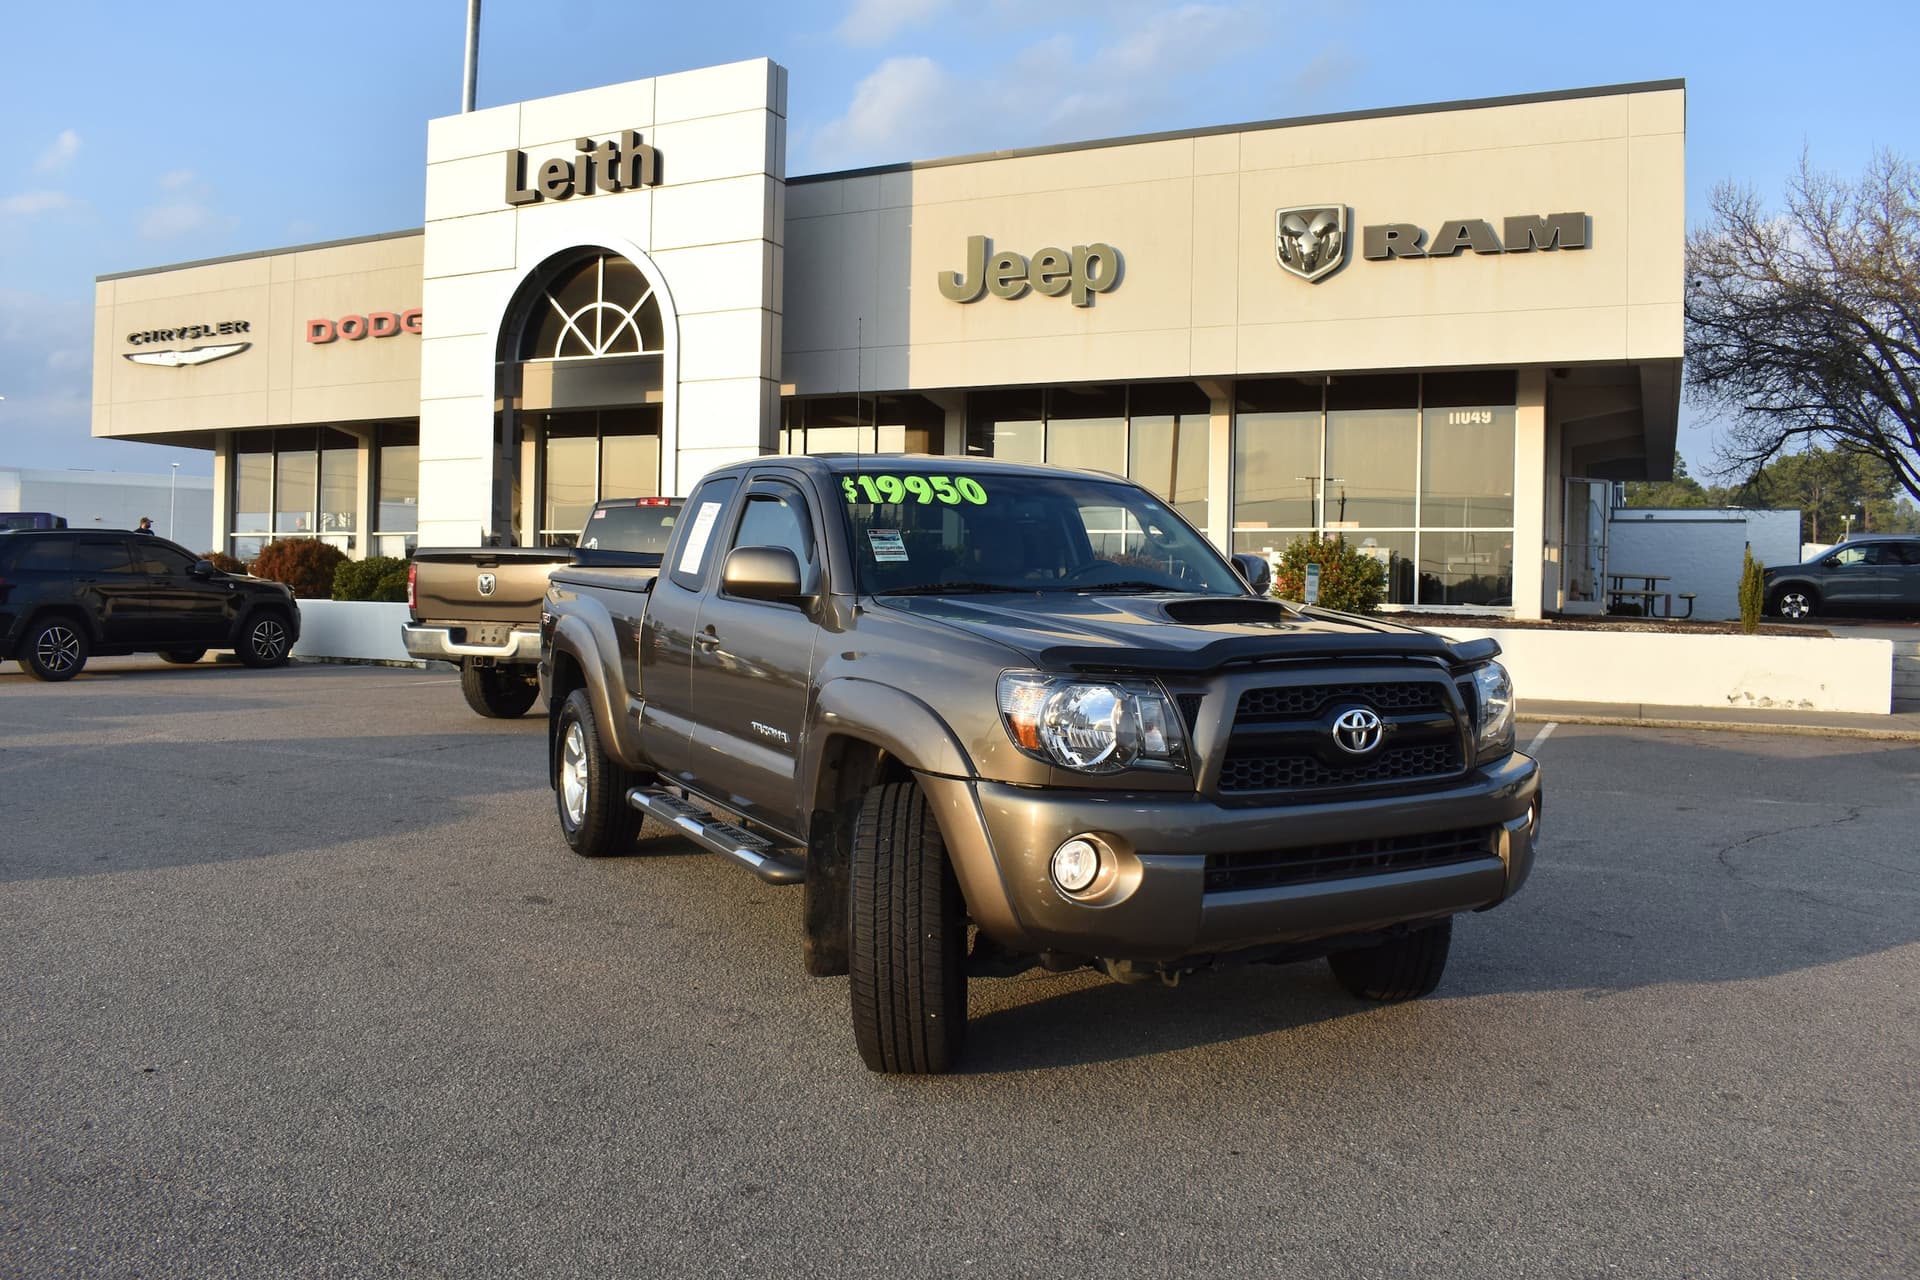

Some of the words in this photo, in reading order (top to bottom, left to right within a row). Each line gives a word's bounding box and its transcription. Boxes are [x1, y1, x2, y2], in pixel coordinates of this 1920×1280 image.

[506, 129, 662, 206] Leith
[1363, 212, 1590, 260] RAM
[938, 235, 1122, 307] Jeep
[127, 320, 251, 345] CHRYSLER
[1449, 411, 1491, 425] 11049
[842, 475, 988, 505] $19950
